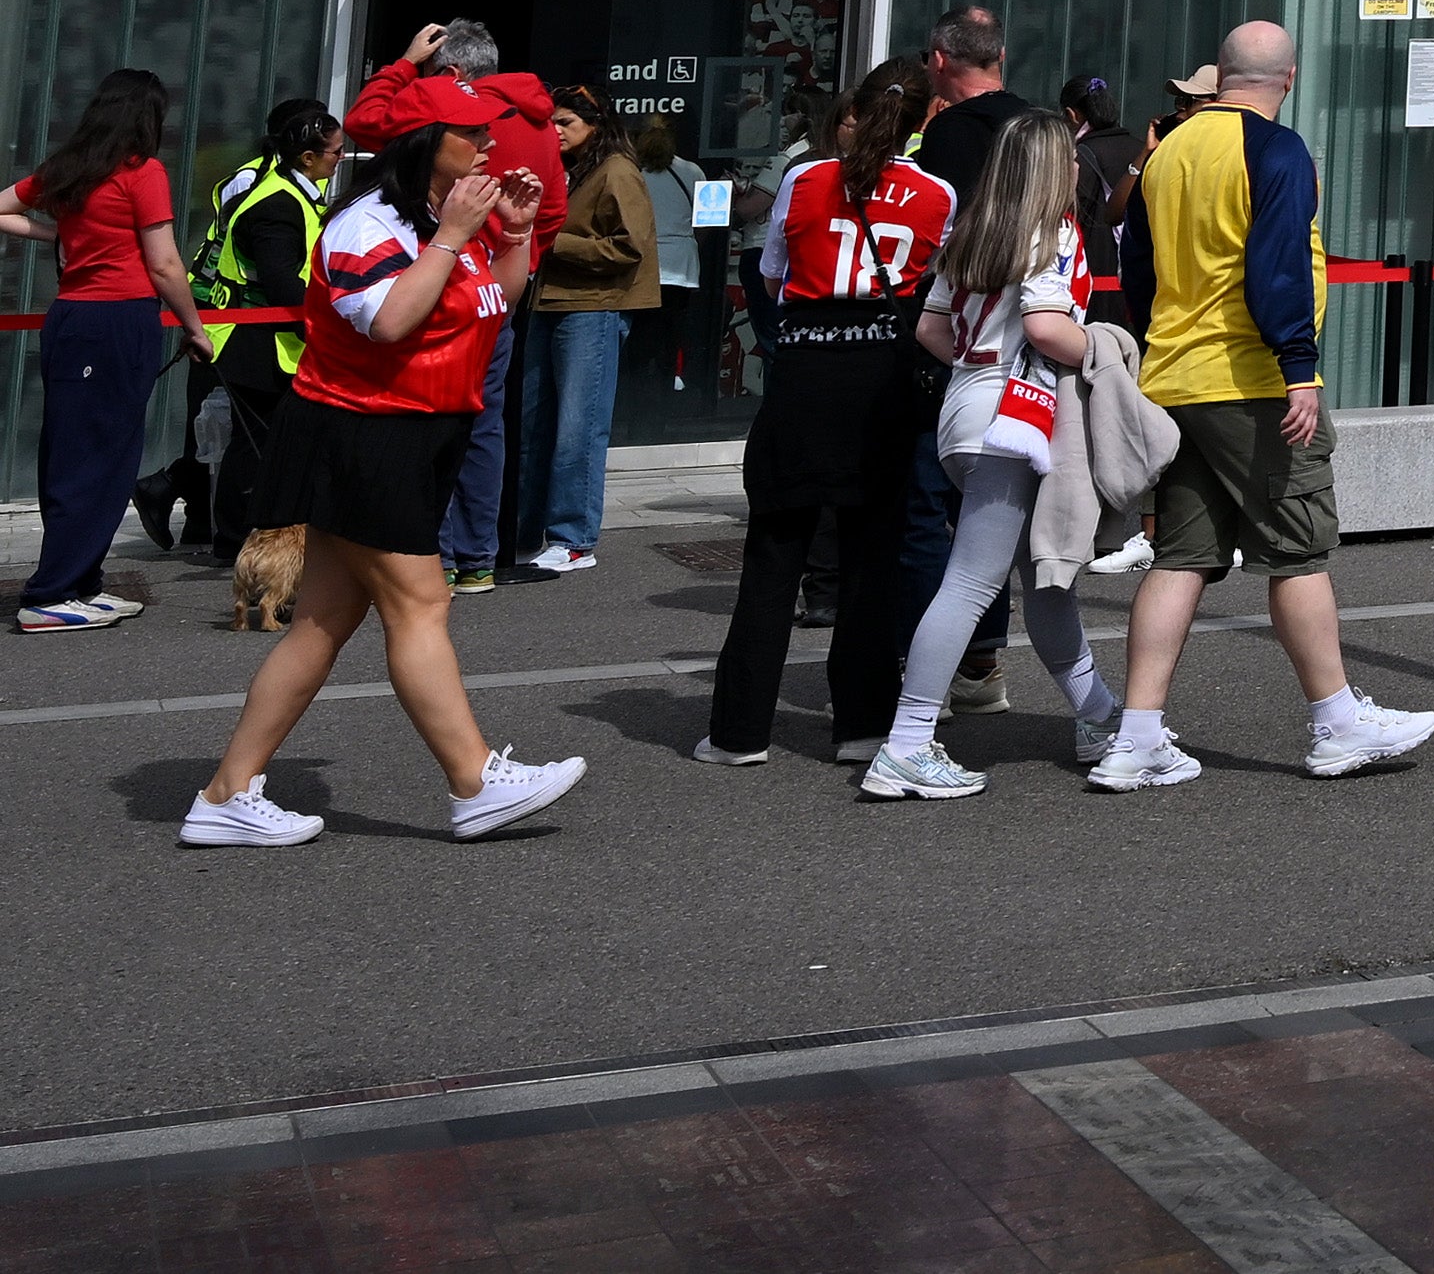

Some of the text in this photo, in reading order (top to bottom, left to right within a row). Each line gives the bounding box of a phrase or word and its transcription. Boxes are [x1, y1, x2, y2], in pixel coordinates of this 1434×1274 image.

[609, 59, 657, 81] and
[611, 96, 686, 114] rance
[829, 217, 915, 299] 18
[476, 284, 508, 319] JVC
[1012, 383, 1058, 418] RUSS
